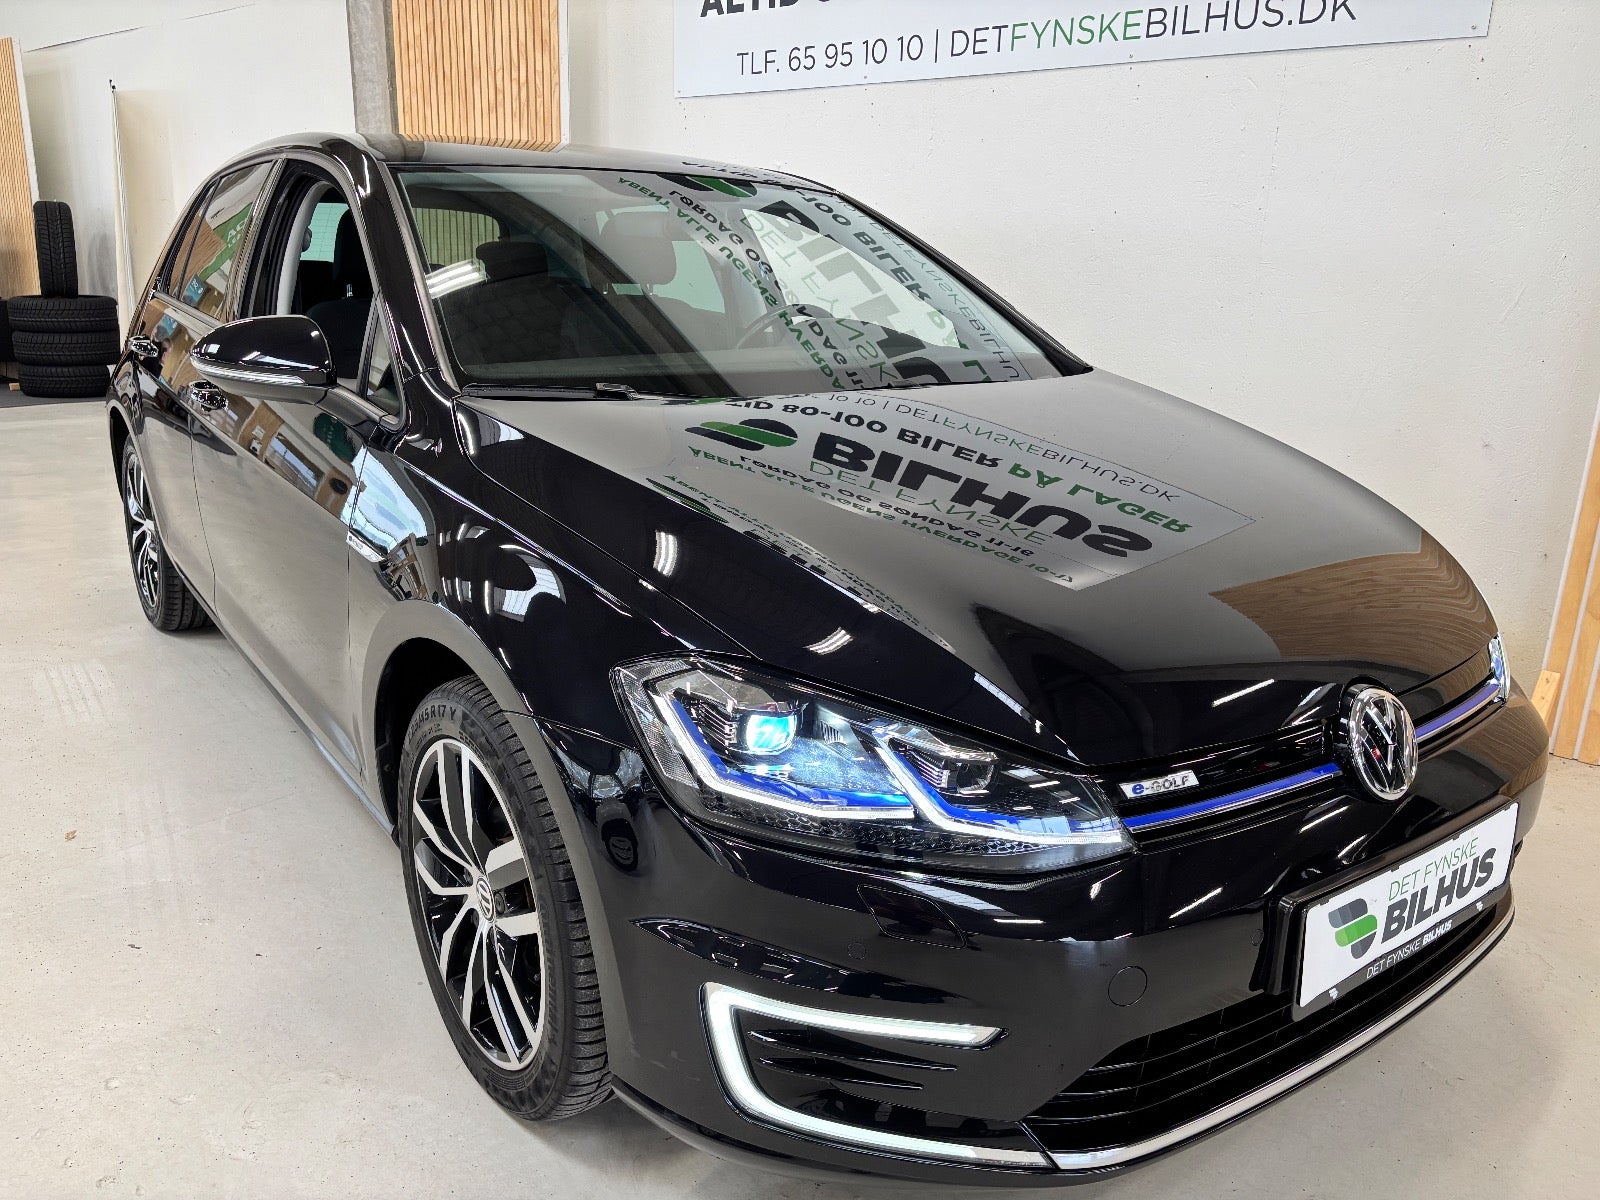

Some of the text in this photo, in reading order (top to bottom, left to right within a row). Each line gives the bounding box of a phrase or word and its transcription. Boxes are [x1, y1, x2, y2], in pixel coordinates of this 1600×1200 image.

[737, 50, 780, 75] TLF.
[788, 45, 816, 71] 65
[825, 42, 853, 69] 95
[862, 38, 888, 65] 10
[897, 34, 924, 62] 10
[950, 0, 1357, 58] DETFYNSKEBILHUS.DK
[1131, 774, 1190, 795] e-GOLF
[1381, 847, 1497, 945] BILHUS
[1388, 837, 1479, 902] DET FYNSKE
[1366, 919, 1453, 980] DET FYNSKE BILHUS
